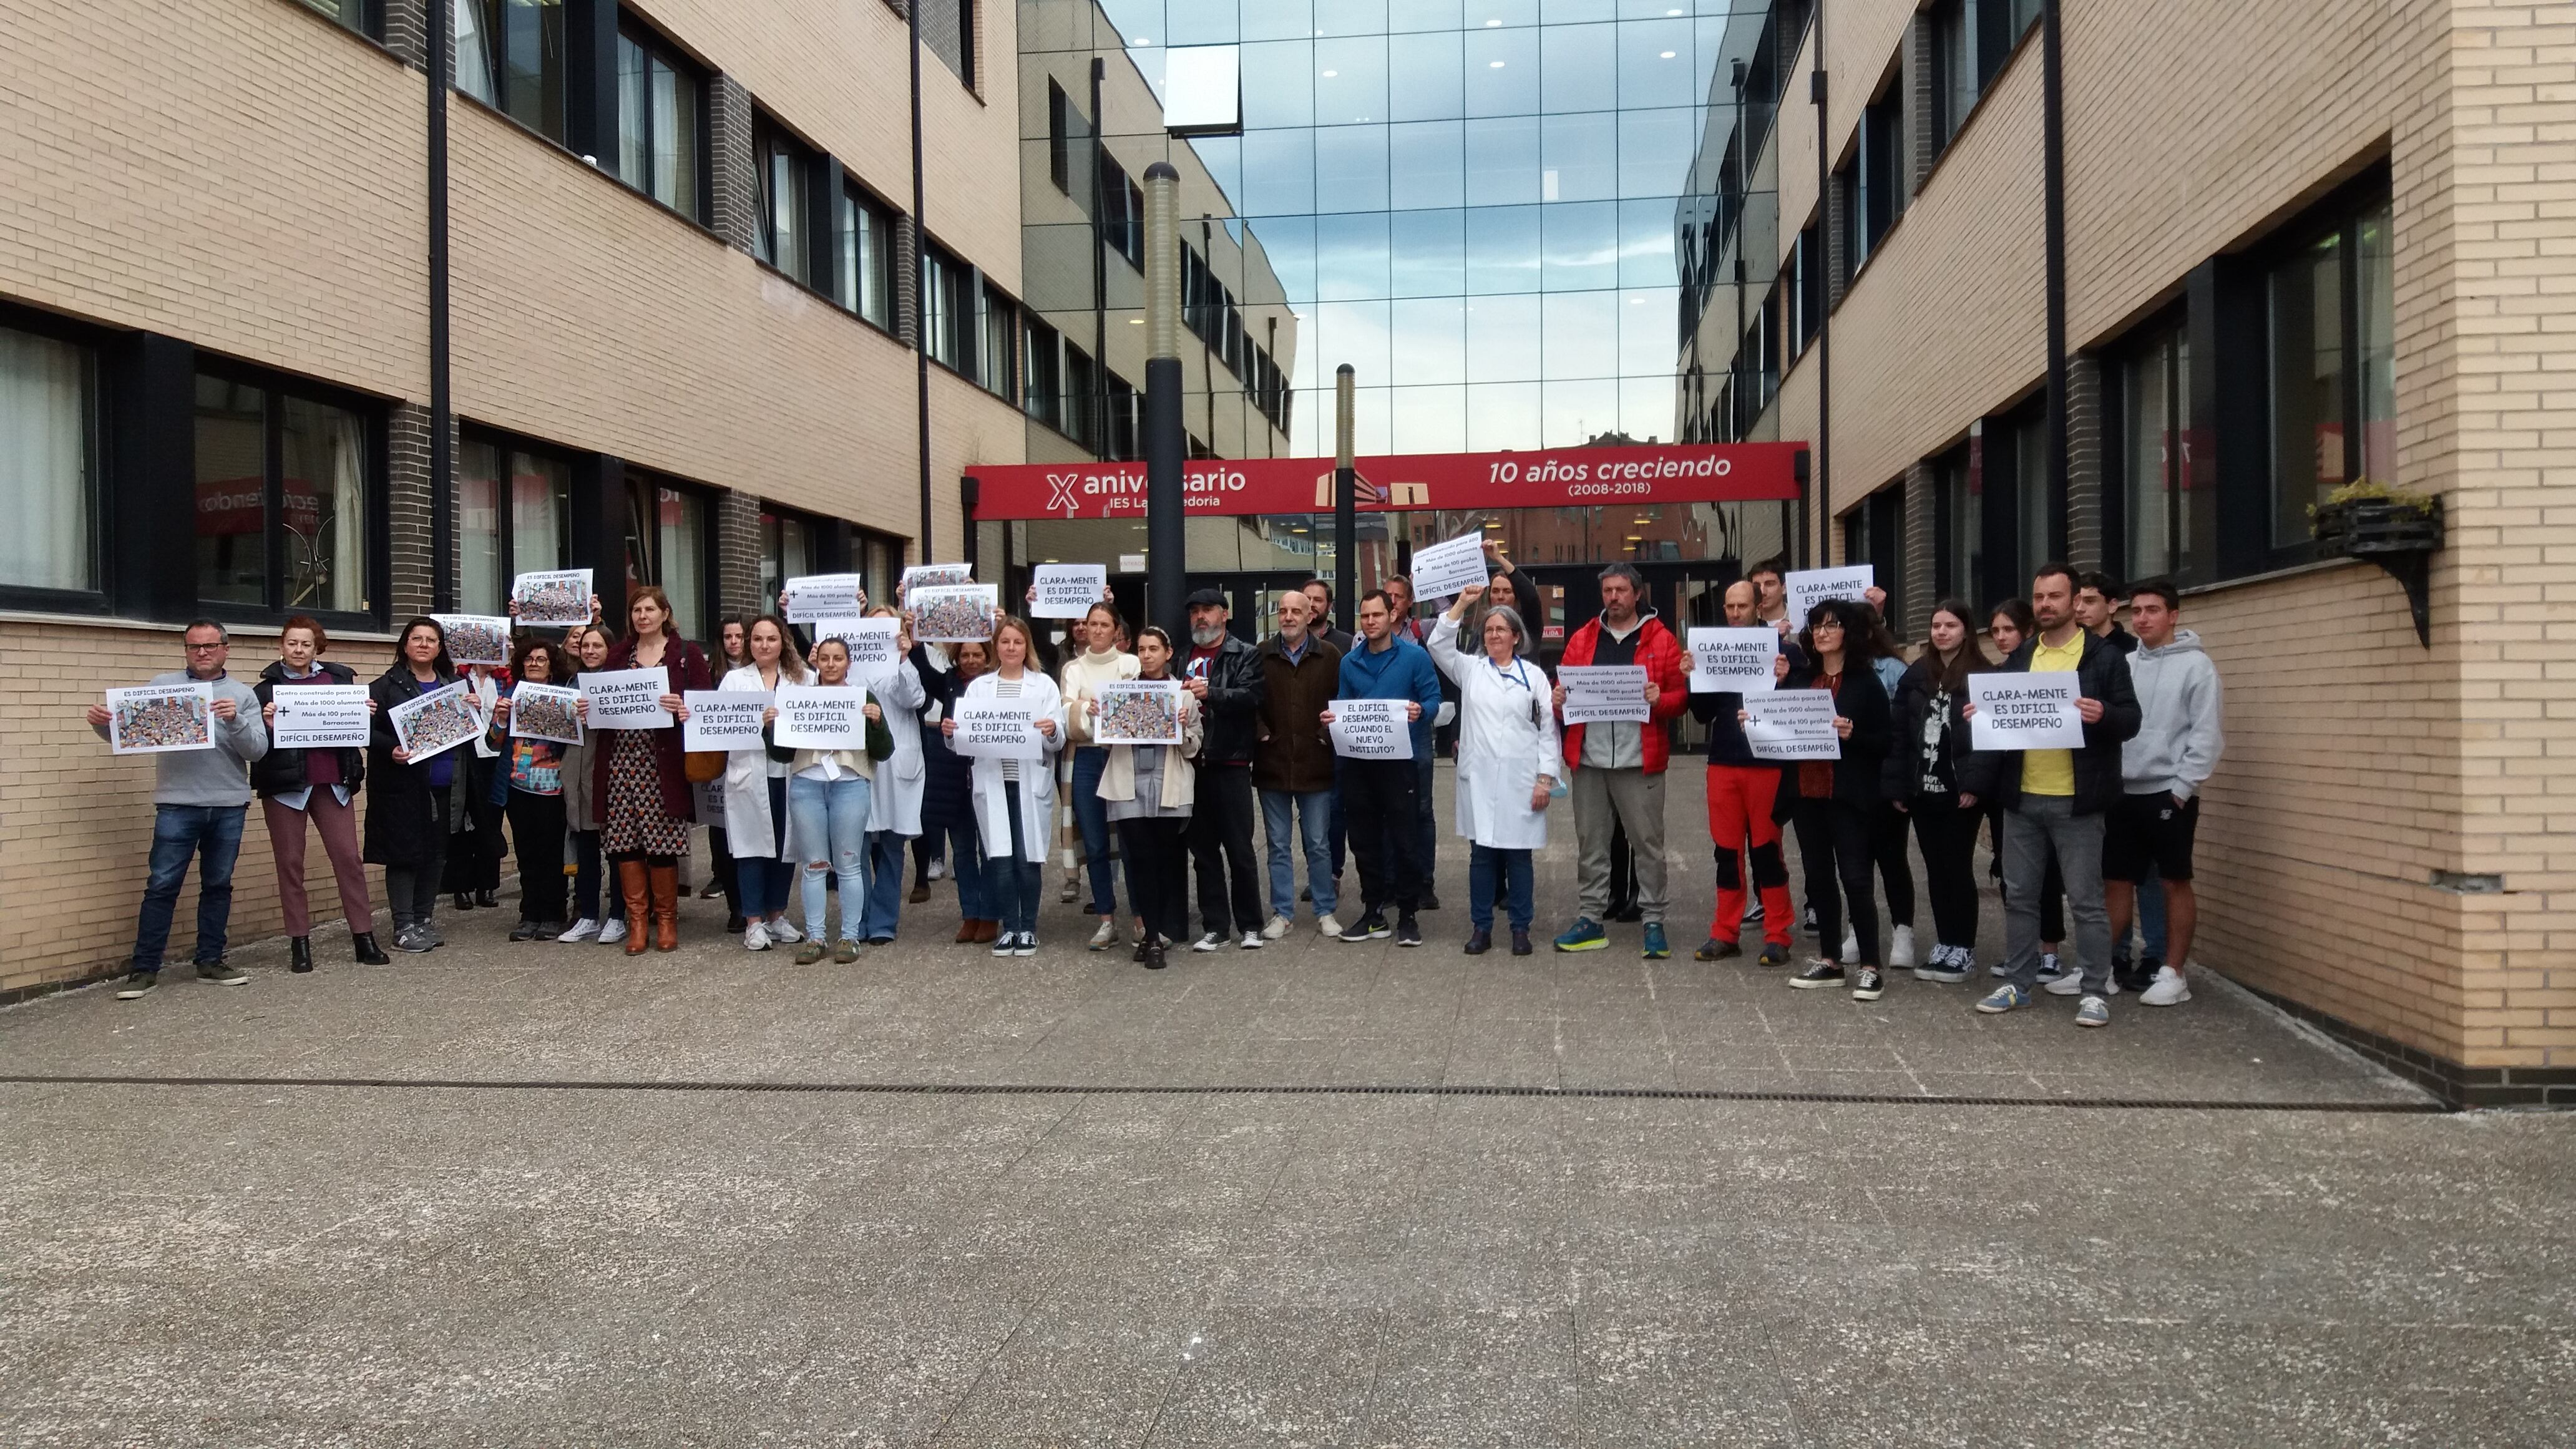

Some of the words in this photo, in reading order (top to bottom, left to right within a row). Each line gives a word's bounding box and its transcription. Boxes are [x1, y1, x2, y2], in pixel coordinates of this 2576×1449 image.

[1490, 462, 1518, 484] 10
[1526, 459, 1588, 482] años
[1598, 455, 1731, 481] creciendo
[1046, 474, 1079, 510] X
[1084, 467, 1246, 494] anivario
[1568, 482, 1651, 497] (2008-2018)
[1110, 498, 1129, 509] IES
[1134, 497, 1148, 508] La
[1420, 586, 1442, 595] DIFÍCIL
[1444, 575, 1484, 590] DESEMPEÑO
[1797, 580, 1862, 593] CLARA-MENTE
[1045, 596, 1093, 604] DESEMPEÑO
[1805, 596, 1815, 604] ES
[1699, 643, 1767, 651] CLARA-MENTE
[1722, 654, 1760, 663] DIFÍCIL
[1706, 665, 1764, 676] DESEMPEÑO
[589, 681, 658, 694] CLARA-MENTE
[613, 693, 651, 704] DIFÍCIL
[1983, 689, 2068, 701] CLARA-MENTE
[599, 703, 656, 715] DESEMPEÑO
[695, 704, 764, 712] CLARA-MENTE
[786, 701, 856, 709] CLARA-MENTE
[1359, 703, 1388, 711] DIFÍCIL
[1995, 705, 2008, 715] ES
[2012, 702, 2059, 714] DIFÍCIL
[809, 711, 847, 721] DIFÍCIL
[964, 711, 1031, 720] CLARA-MENTE
[1569, 709, 1596, 718] DIFÍCIL
[1599, 707, 1647, 716] DESEMPEÑO
[718, 714, 756, 723] DIFÍCIL
[1993, 716, 2062, 729] DESEMPEÑO
[701, 725, 759, 734] DESEMPEÑO
[791, 723, 850, 733] DESEMPEÑO
[972, 723, 982, 731] ES
[986, 722, 1023, 731] DIFÍCIL
[1345, 725, 1382, 733] ¿CUANDO
[281, 733, 310, 742] DIFÍCIL
[313, 733, 364, 741] DESEMPEÑO
[969, 734, 1026, 743] DESEMPEÑO
[1757, 744, 1783, 753] DIFÍCIL
[1787, 743, 1835, 752] DESEMPEÑO
